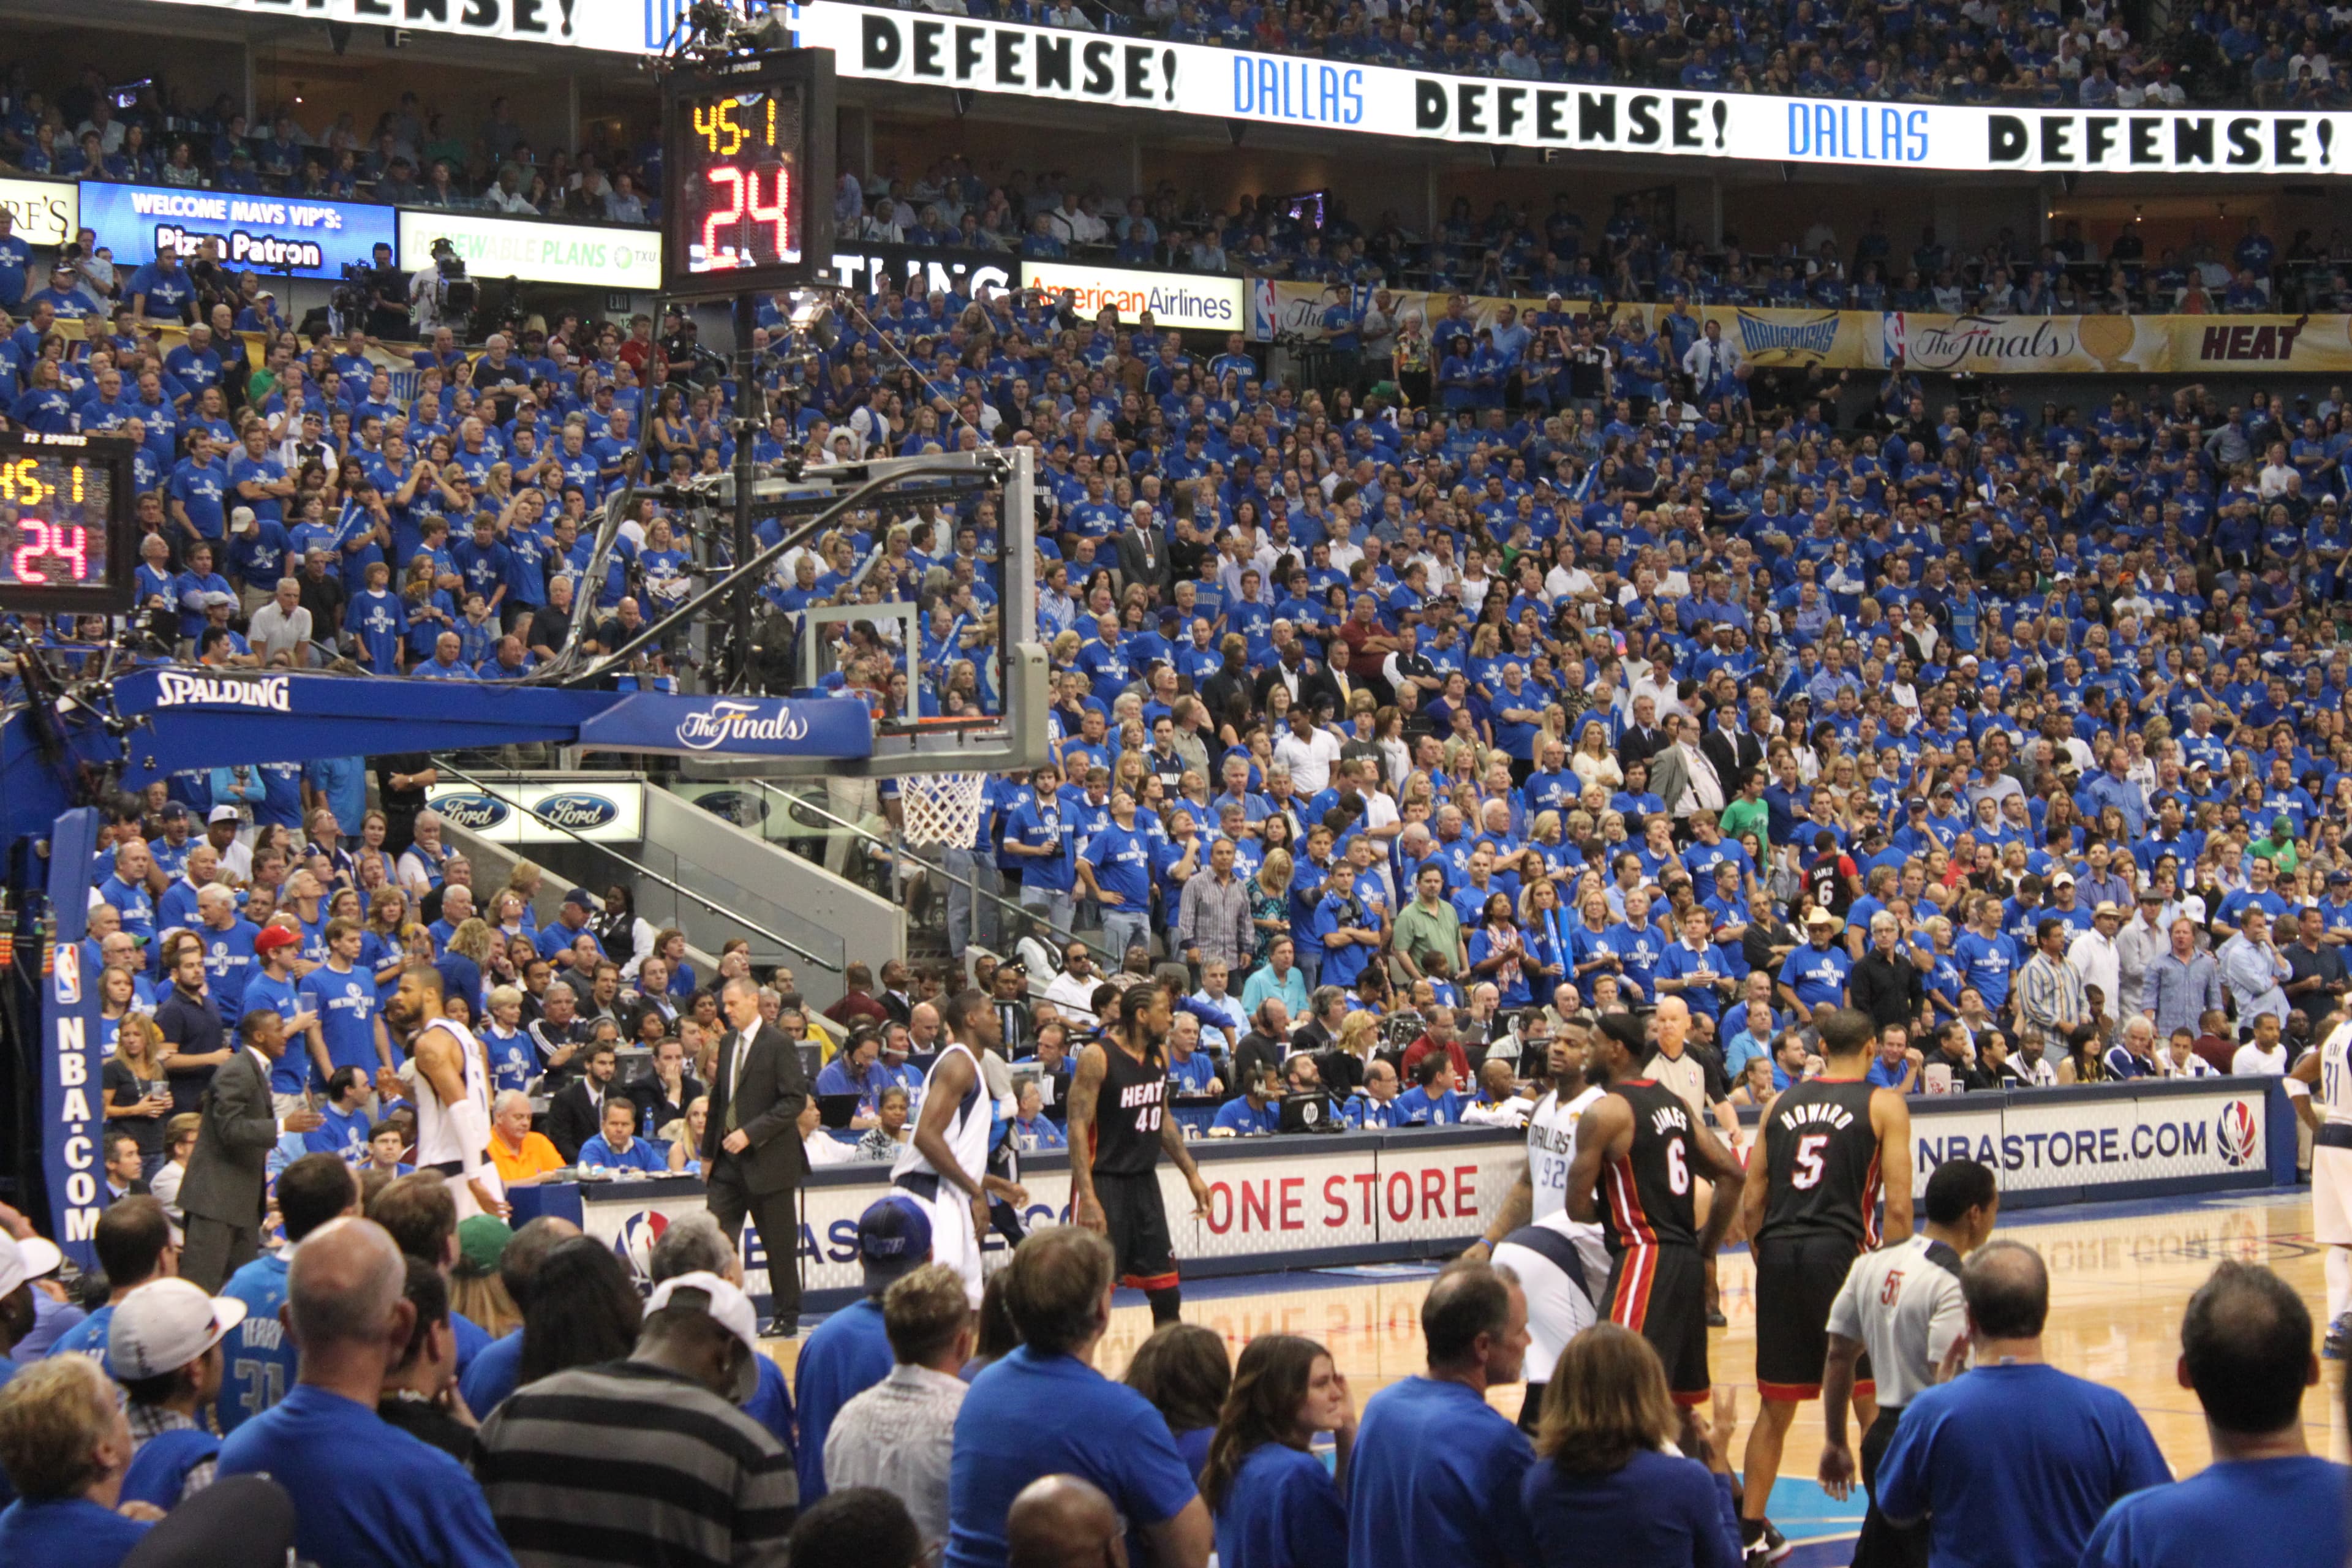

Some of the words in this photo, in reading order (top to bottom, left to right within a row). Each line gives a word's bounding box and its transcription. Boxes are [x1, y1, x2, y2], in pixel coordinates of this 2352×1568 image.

[861, 13, 1178, 104] DEFENSE!
[1234, 55, 1363, 124] DALLAS
[1415, 78, 1728, 150] DEFENSE!
[1788, 102, 1929, 162] DALLAS
[1988, 114, 2334, 165] DEFENSE!
[131, 192, 227, 220] WELCOME
[230, 200, 286, 225] MAVS
[289, 205, 342, 229] VIP'S:
[703, 166, 790, 270] 24
[233, 233, 320, 266] Patron
[541, 239, 607, 268] PLANS
[635, 245, 657, 262] TXU
[1737, 312, 1840, 353] MAVERICKS
[1912, 328, 1958, 356] The
[1953, 315, 2075, 361] Finals
[2201, 321, 2306, 360] HEAT
[43, 434, 88, 447] SPORTS
[13, 519, 87, 583] 24
[157, 672, 292, 712] SPALDING
[681, 712, 720, 737] The
[710, 701, 809, 745] Finals
[439, 797, 494, 826] Ford
[549, 797, 603, 825] Ford
[1813, 867, 1833, 880] JAMES
[1818, 880, 1834, 905] 6
[1120, 1077, 1166, 1109] HEAT
[57, 1017, 100, 1242] NBA.COM
[1135, 1106, 1162, 1133] 40
[1305, 1104, 1317, 1123] hp
[1652, 1107, 1687, 1135] JAMES
[1781, 1103, 1854, 1130] HOWARD
[1531, 1124, 1572, 1155] DALLAS
[1918, 1121, 2206, 1172] NBASTORE.COM
[1541, 1158, 1566, 1189] 92
[1665, 1137, 1691, 1196] 6
[1792, 1134, 1830, 1191] 5
[1207, 1177, 1305, 1235] ONE
[1323, 1166, 1479, 1228] STORE
[242, 1317, 285, 1351] TERRY
[235, 1357, 285, 1414] 31
